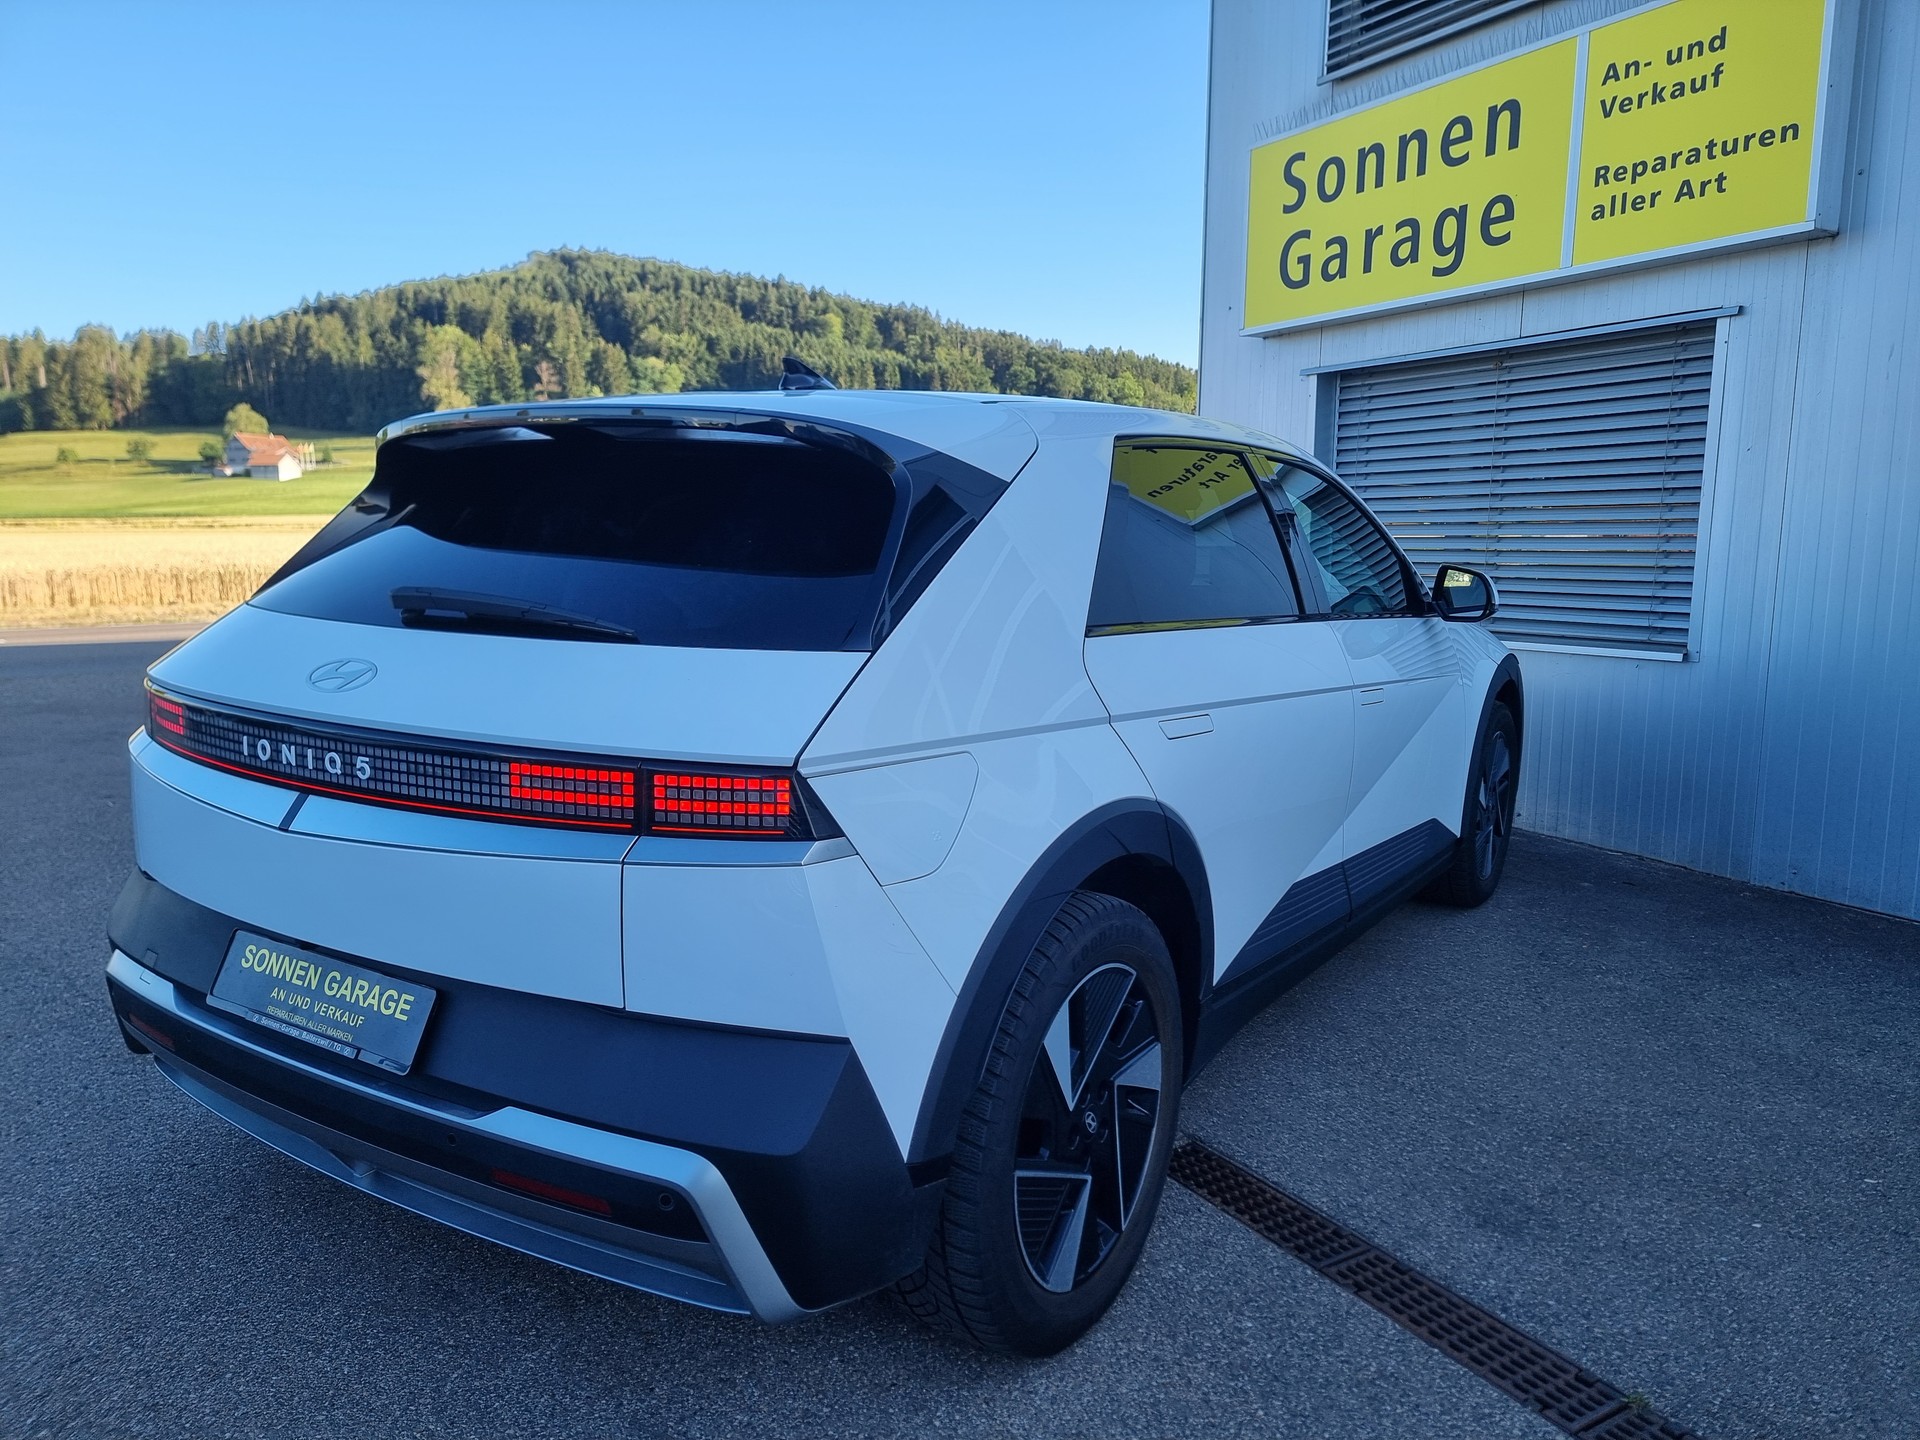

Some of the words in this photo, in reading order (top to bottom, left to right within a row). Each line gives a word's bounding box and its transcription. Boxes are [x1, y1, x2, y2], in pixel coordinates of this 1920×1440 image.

[1601, 58, 1653, 87] An-
[1666, 26, 1729, 67] und
[1599, 62, 1725, 120] Verkauf
[1281, 97, 1523, 215] Sonnen
[1594, 122, 1801, 188] Reparaturen
[1590, 187, 1663, 222] aller
[1673, 170, 1729, 203] Art
[1278, 192, 1516, 290] Garage
[242, 735, 342, 776] IONIQ
[355, 756, 371, 780] 5
[241, 944, 322, 991] SONNEN
[324, 970, 415, 1021] GARAGE
[270, 986, 287, 1002] AN
[289, 991, 310, 1010] UND
[314, 1000, 365, 1028] VERKAUF
[260, 1016, 300, 1036] Sonnen-Garage
[266, 1005, 307, 1026] REPARATUREN
[306, 1020, 328, 1033] ALLER
[326, 1027, 354, 1043] MARKEN
